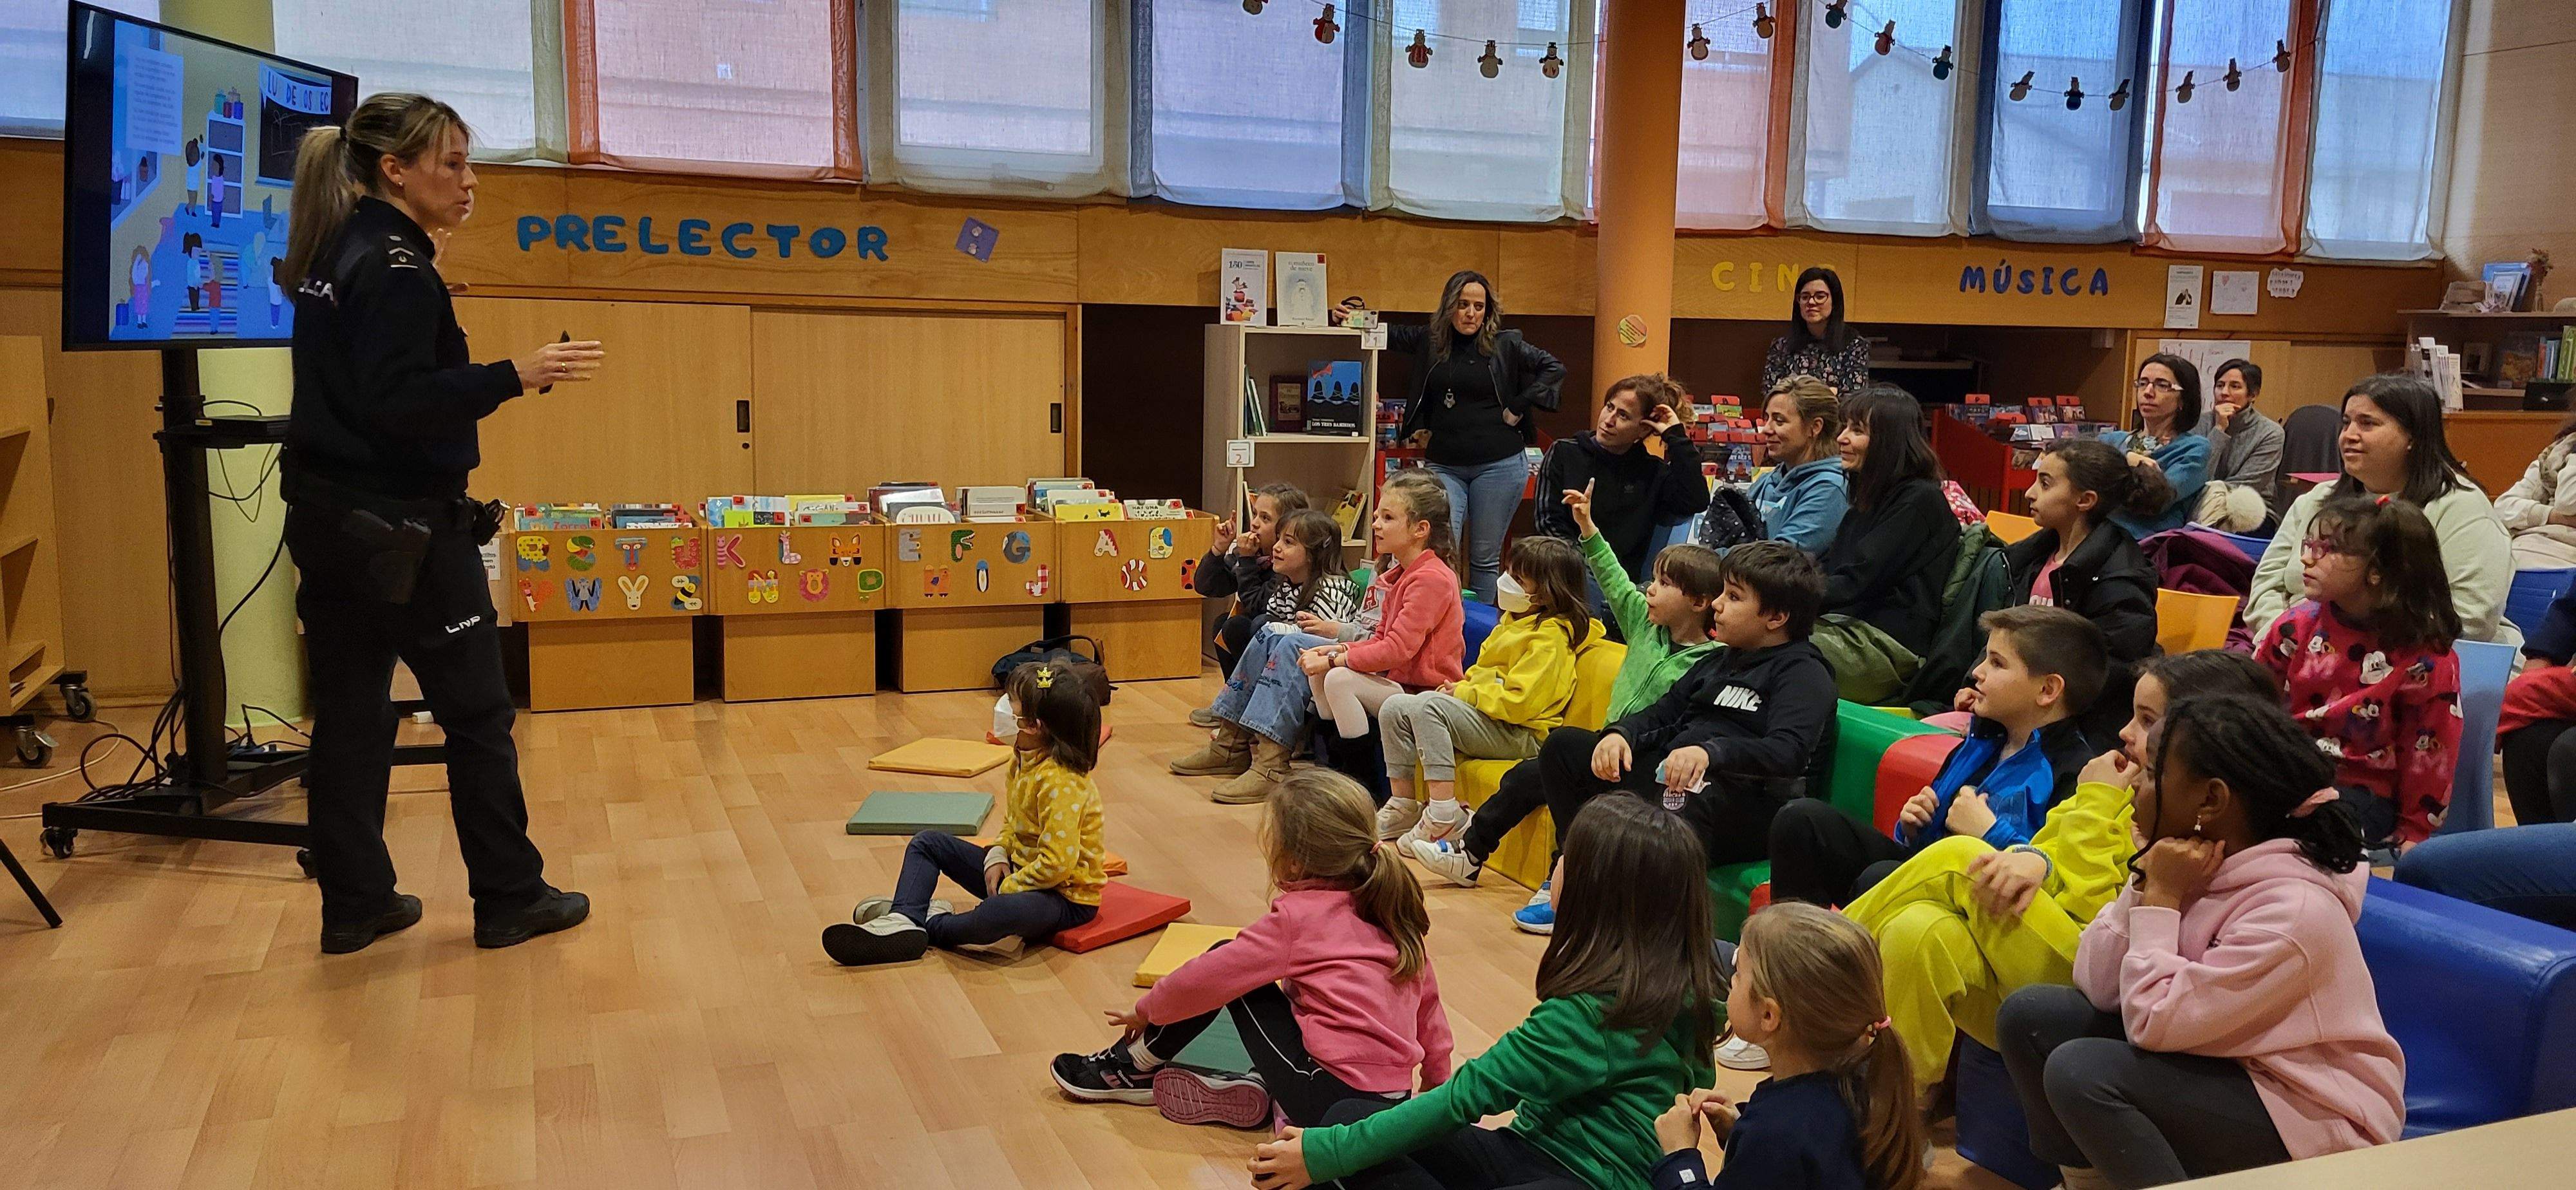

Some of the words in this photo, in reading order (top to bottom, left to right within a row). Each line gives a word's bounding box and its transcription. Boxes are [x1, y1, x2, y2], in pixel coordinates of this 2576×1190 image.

[517, 214, 889, 261] PRELECTOR
[1229, 260, 1243, 269] 150
[1711, 261, 1835, 293] CIN
[1960, 259, 2108, 296] MÚSICA
[1236, 453, 1243, 464] 2
[516, 535, 551, 572] R
[567, 535, 596, 571] S
[615, 537, 649, 571] T
[671, 537, 701, 570] U
[716, 534, 745, 570] K
[779, 529, 802, 564] L
[898, 529, 921, 562] E
[951, 529, 976, 562] F
[1002, 531, 1031, 563] G
[1094, 528, 1119, 556] A
[1150, 527, 1173, 558] B
[565, 577, 602, 612] W
[618, 574, 649, 610] Y
[1025, 563, 1049, 597] J
[1714, 685, 1762, 712] NIKE
[1117, 1069, 1133, 1088] Reebok
